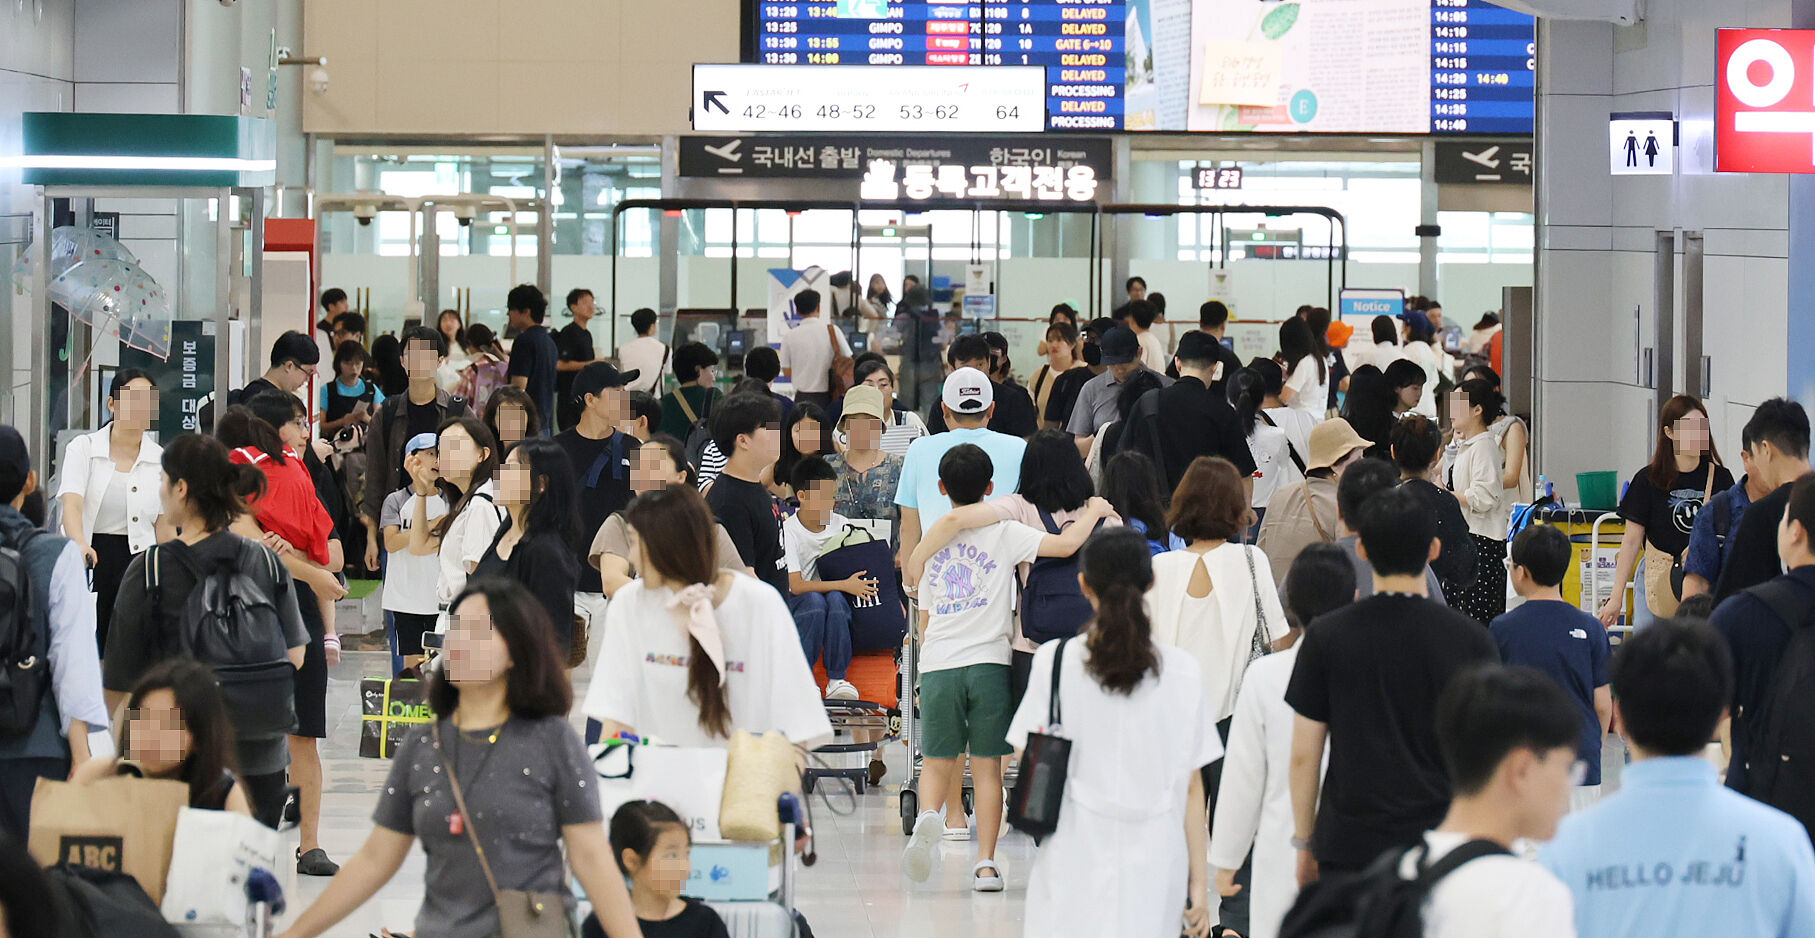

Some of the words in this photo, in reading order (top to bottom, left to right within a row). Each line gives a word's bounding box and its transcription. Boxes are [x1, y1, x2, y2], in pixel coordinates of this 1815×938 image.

[1061, 8, 1106, 19] DELAYED
[766, 22, 798, 33] 13:25
[869, 23, 903, 34] GIMPO
[1061, 23, 1106, 35] DELAYED
[869, 38, 903, 49] GIMPO
[1056, 39, 1080, 50] GATE
[1435, 42, 1467, 53] 14:15
[869, 53, 903, 64] GIMPO
[1061, 54, 1106, 66] DELAYED
[1435, 57, 1467, 69] 14:15
[1061, 70, 1106, 81] DELAYED
[1051, 85, 1115, 97] PROCESSING
[743, 104, 802, 119] 42~46
[816, 104, 876, 119] 48~52
[900, 104, 959, 119] 53~62
[996, 105, 1019, 119] 64
[1061, 101, 1106, 112] DELAYED
[1051, 116, 1115, 128] PROCESSING
[752, 146, 815, 169] 국내선
[819, 146, 861, 169] 출발
[1353, 301, 1391, 312] Notice
[182, 341, 197, 388] 보증금
[181, 399, 196, 430] 대상
[929, 547, 951, 587] NEW
[957, 543, 997, 574] YORK
[68, 844, 116, 871] ABC
[1587, 863, 1673, 890] HELLO
[1681, 861, 1744, 888] JEJU
